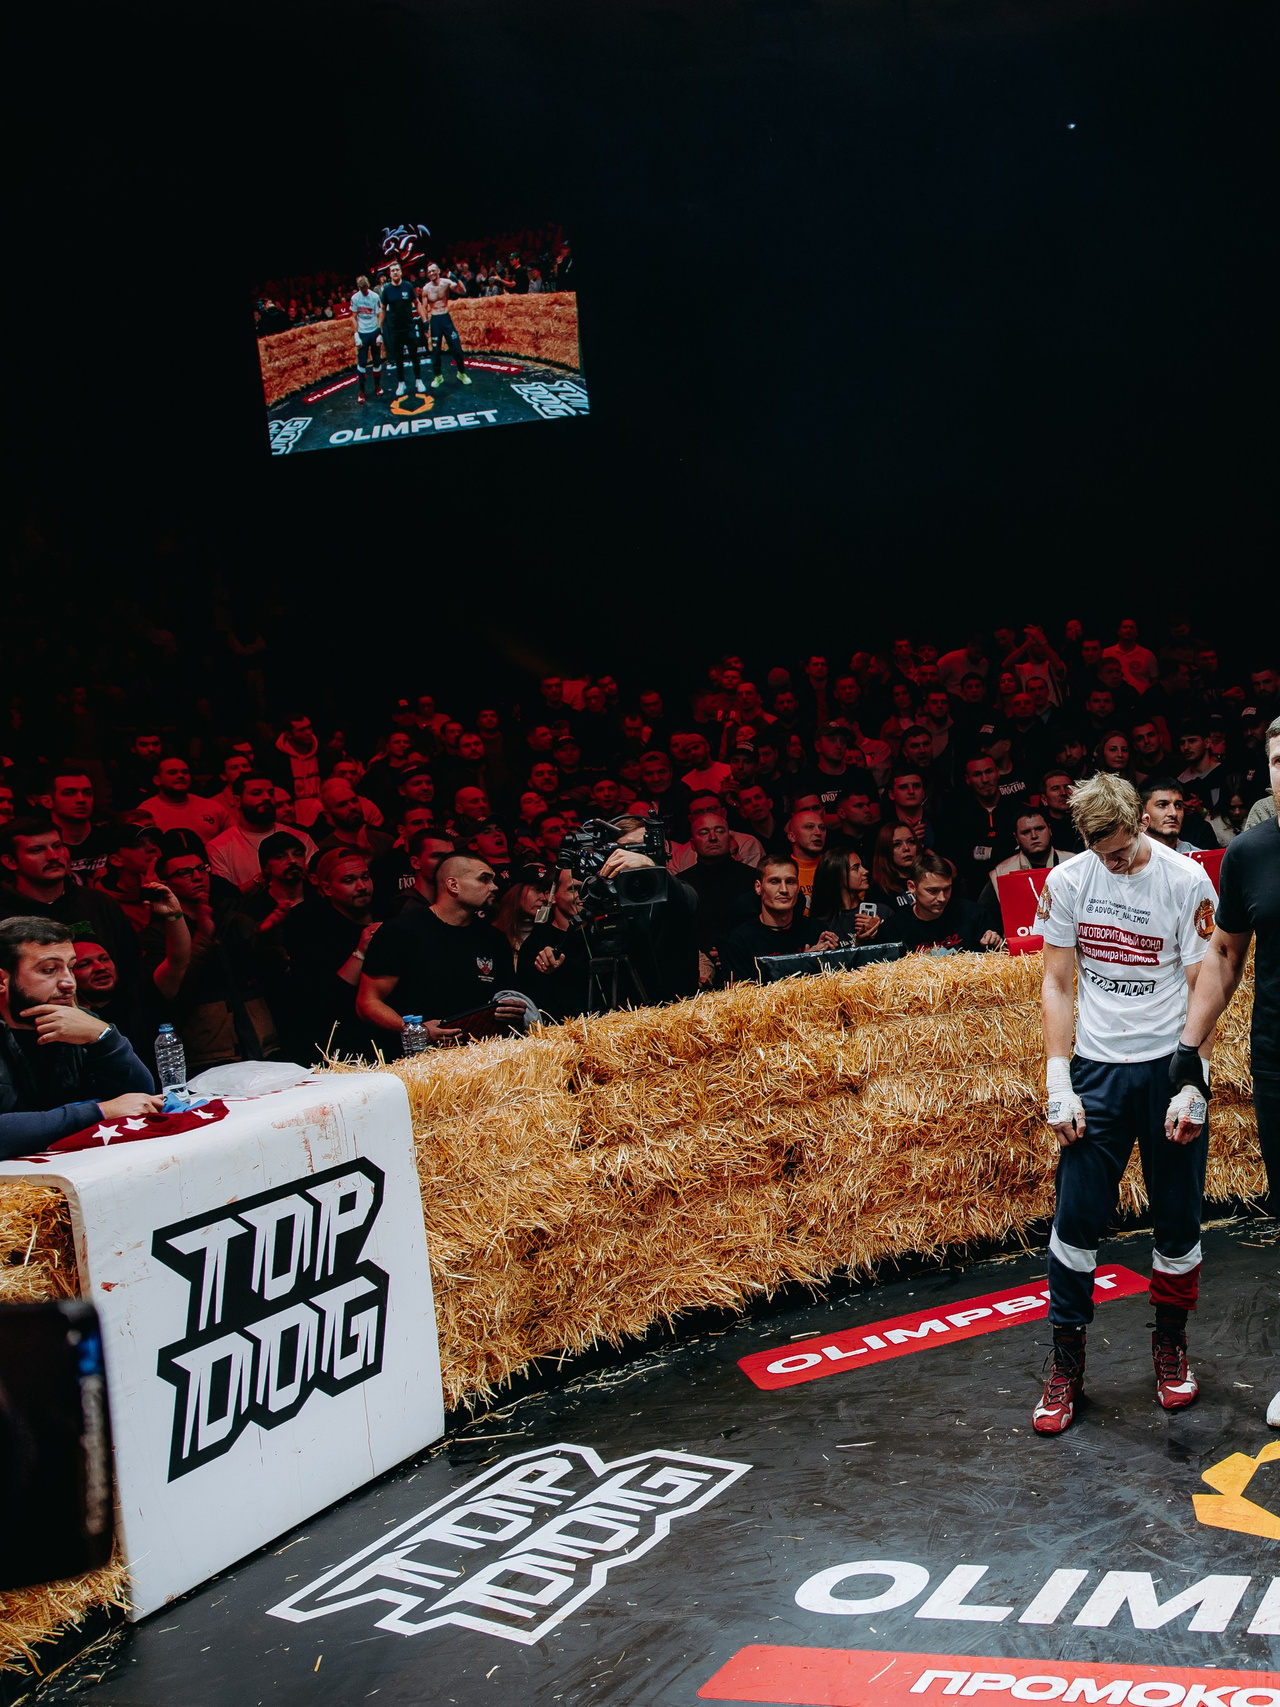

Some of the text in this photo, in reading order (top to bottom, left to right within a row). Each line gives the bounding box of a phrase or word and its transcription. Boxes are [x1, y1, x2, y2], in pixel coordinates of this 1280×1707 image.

[329, 409, 499, 444] OLIMPBET
[1078, 925, 1161, 951] ЛАГОТВОРИТЕЛЬНЫЙ ФОНД
[164, 1168, 377, 1333] TOP
[765, 1272, 1118, 1375] OLIMPBT
[170, 1274, 380, 1461] DOG
[315, 1456, 577, 1602] TOP
[423, 1463, 714, 1620] DOG
